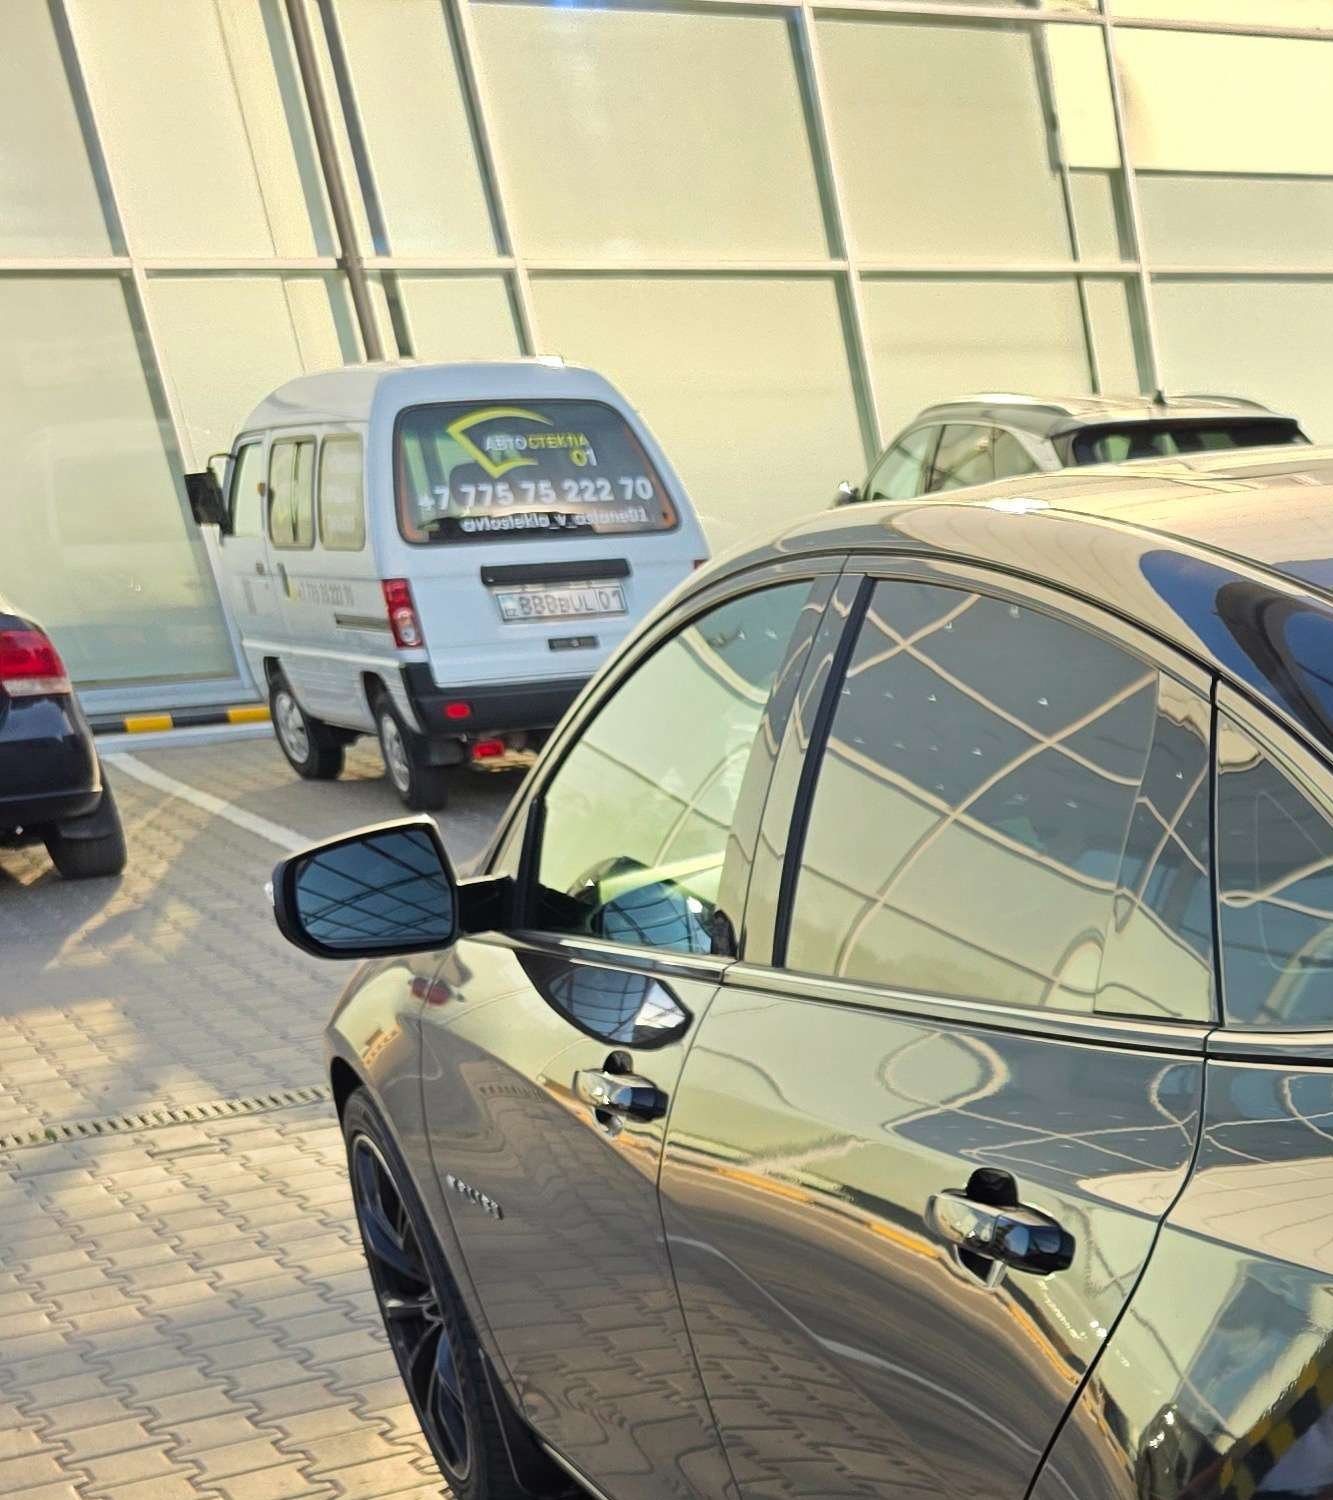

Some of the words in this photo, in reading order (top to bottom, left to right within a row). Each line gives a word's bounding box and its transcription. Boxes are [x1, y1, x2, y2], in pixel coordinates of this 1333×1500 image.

[460, 482, 514, 506] 775
[520, 480, 556, 505] 75
[561, 477, 615, 502] 222
[617, 475, 654, 500] 70
